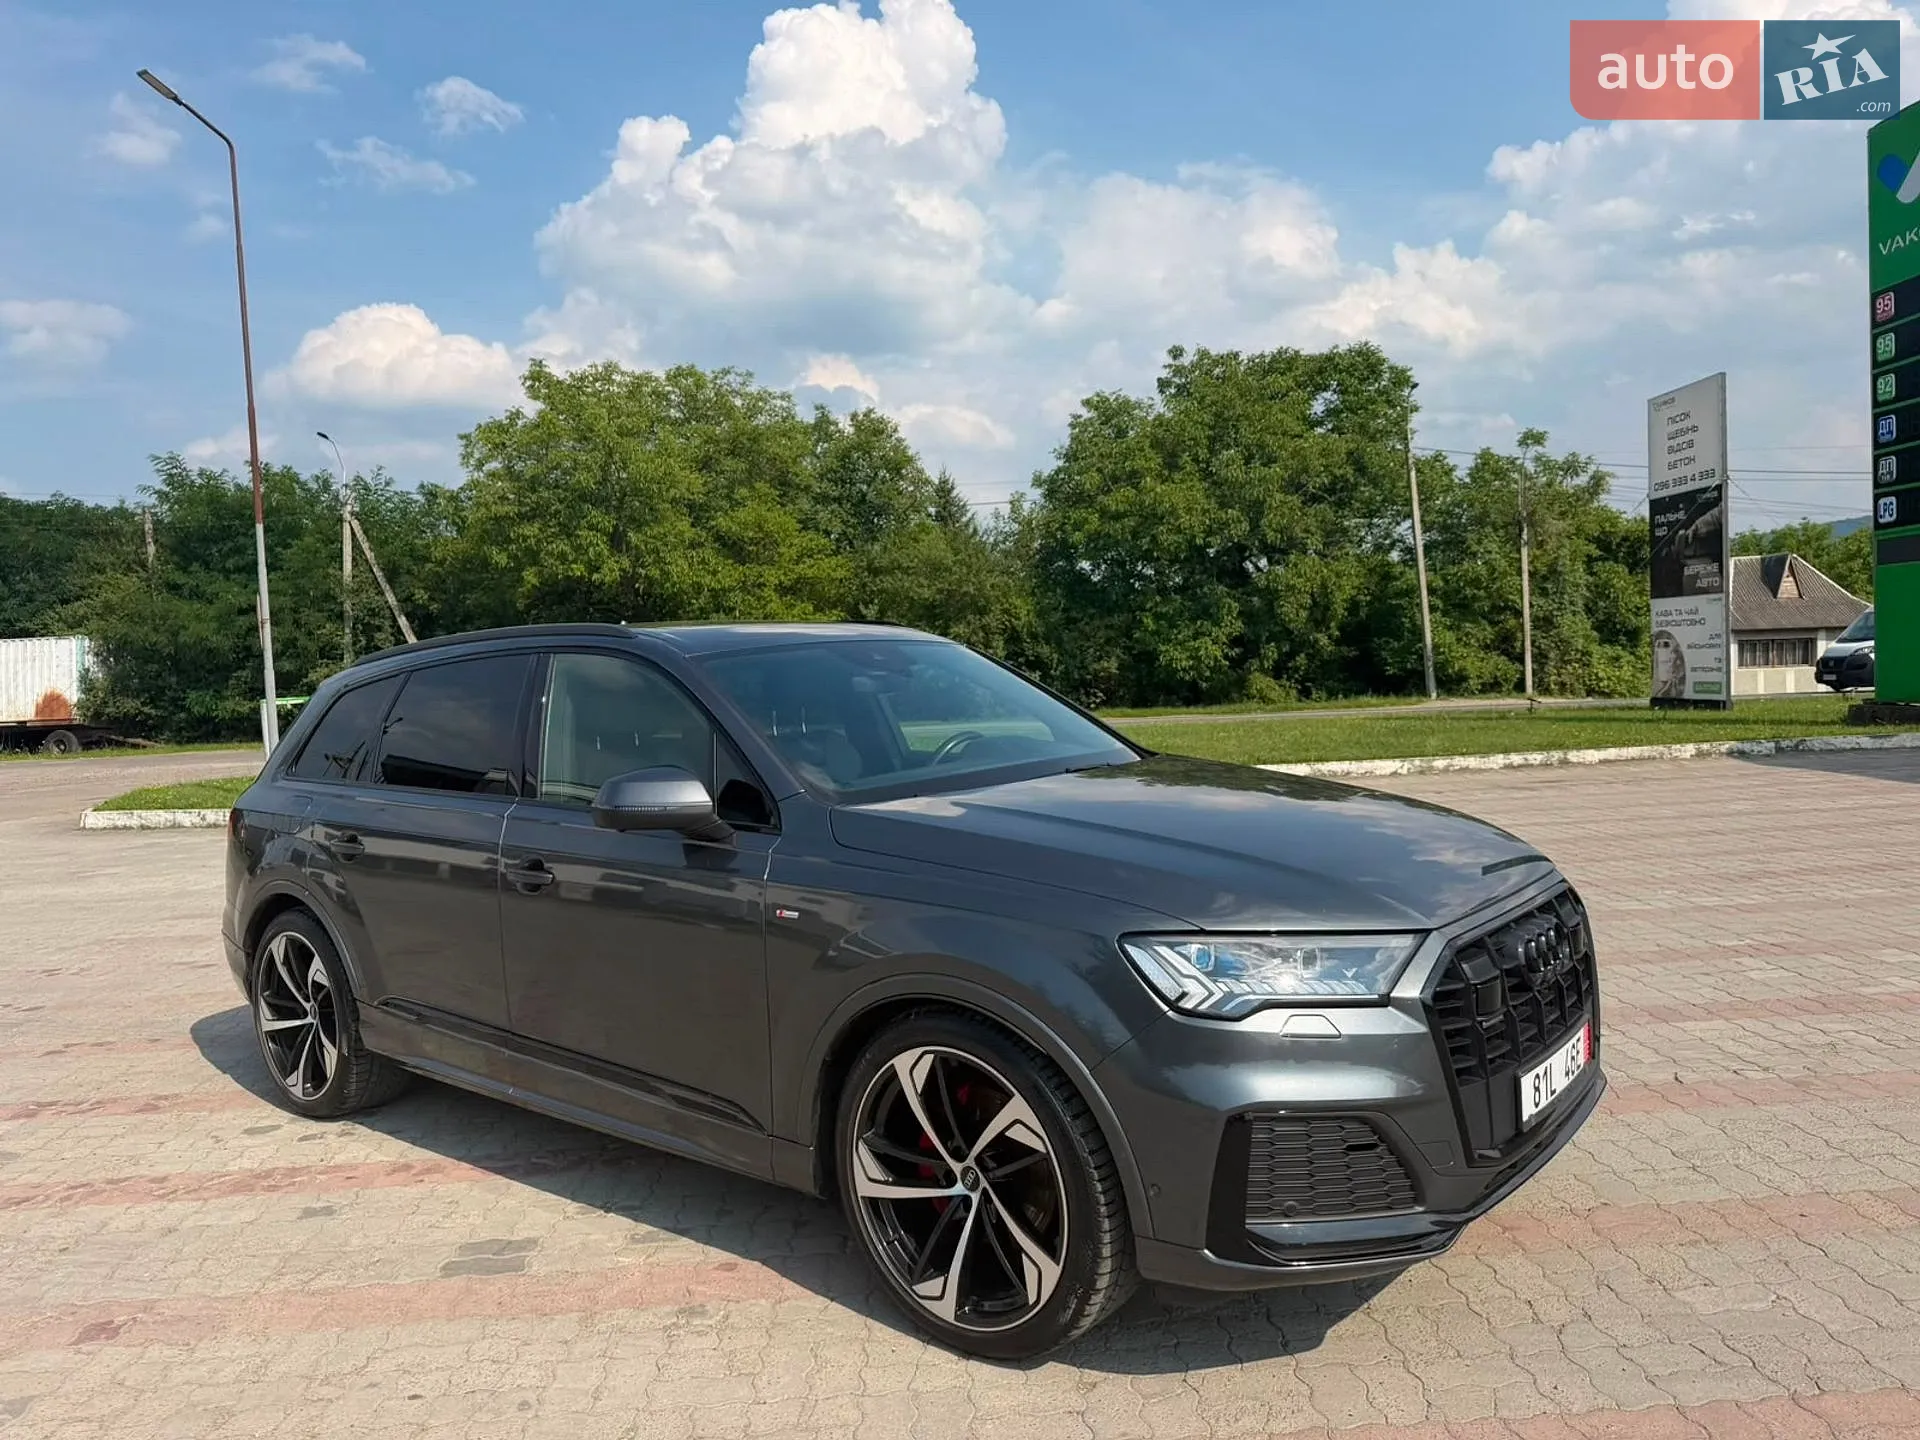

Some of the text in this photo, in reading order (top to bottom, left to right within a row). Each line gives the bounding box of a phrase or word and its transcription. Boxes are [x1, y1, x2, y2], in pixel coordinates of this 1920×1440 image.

[1879, 227, 1920, 255] VAK
[1876, 295, 1892, 313] 95
[1877, 336, 1892, 353] 95
[1877, 377, 1892, 394] 92
[1667, 411, 1691, 426] ПІСОК
[1667, 424, 1699, 441] ЩЕБІНЬ
[1668, 455, 1696, 470] БЕТОН
[1653, 468, 1716, 493] 096 333 4 333
[1878, 501, 1894, 519] LPG
[1696, 577, 1720, 588] АВТО
[1655, 605, 1699, 618] КАВА ТА ЧАЙ
[1533, 1063, 1557, 1109] 81L
